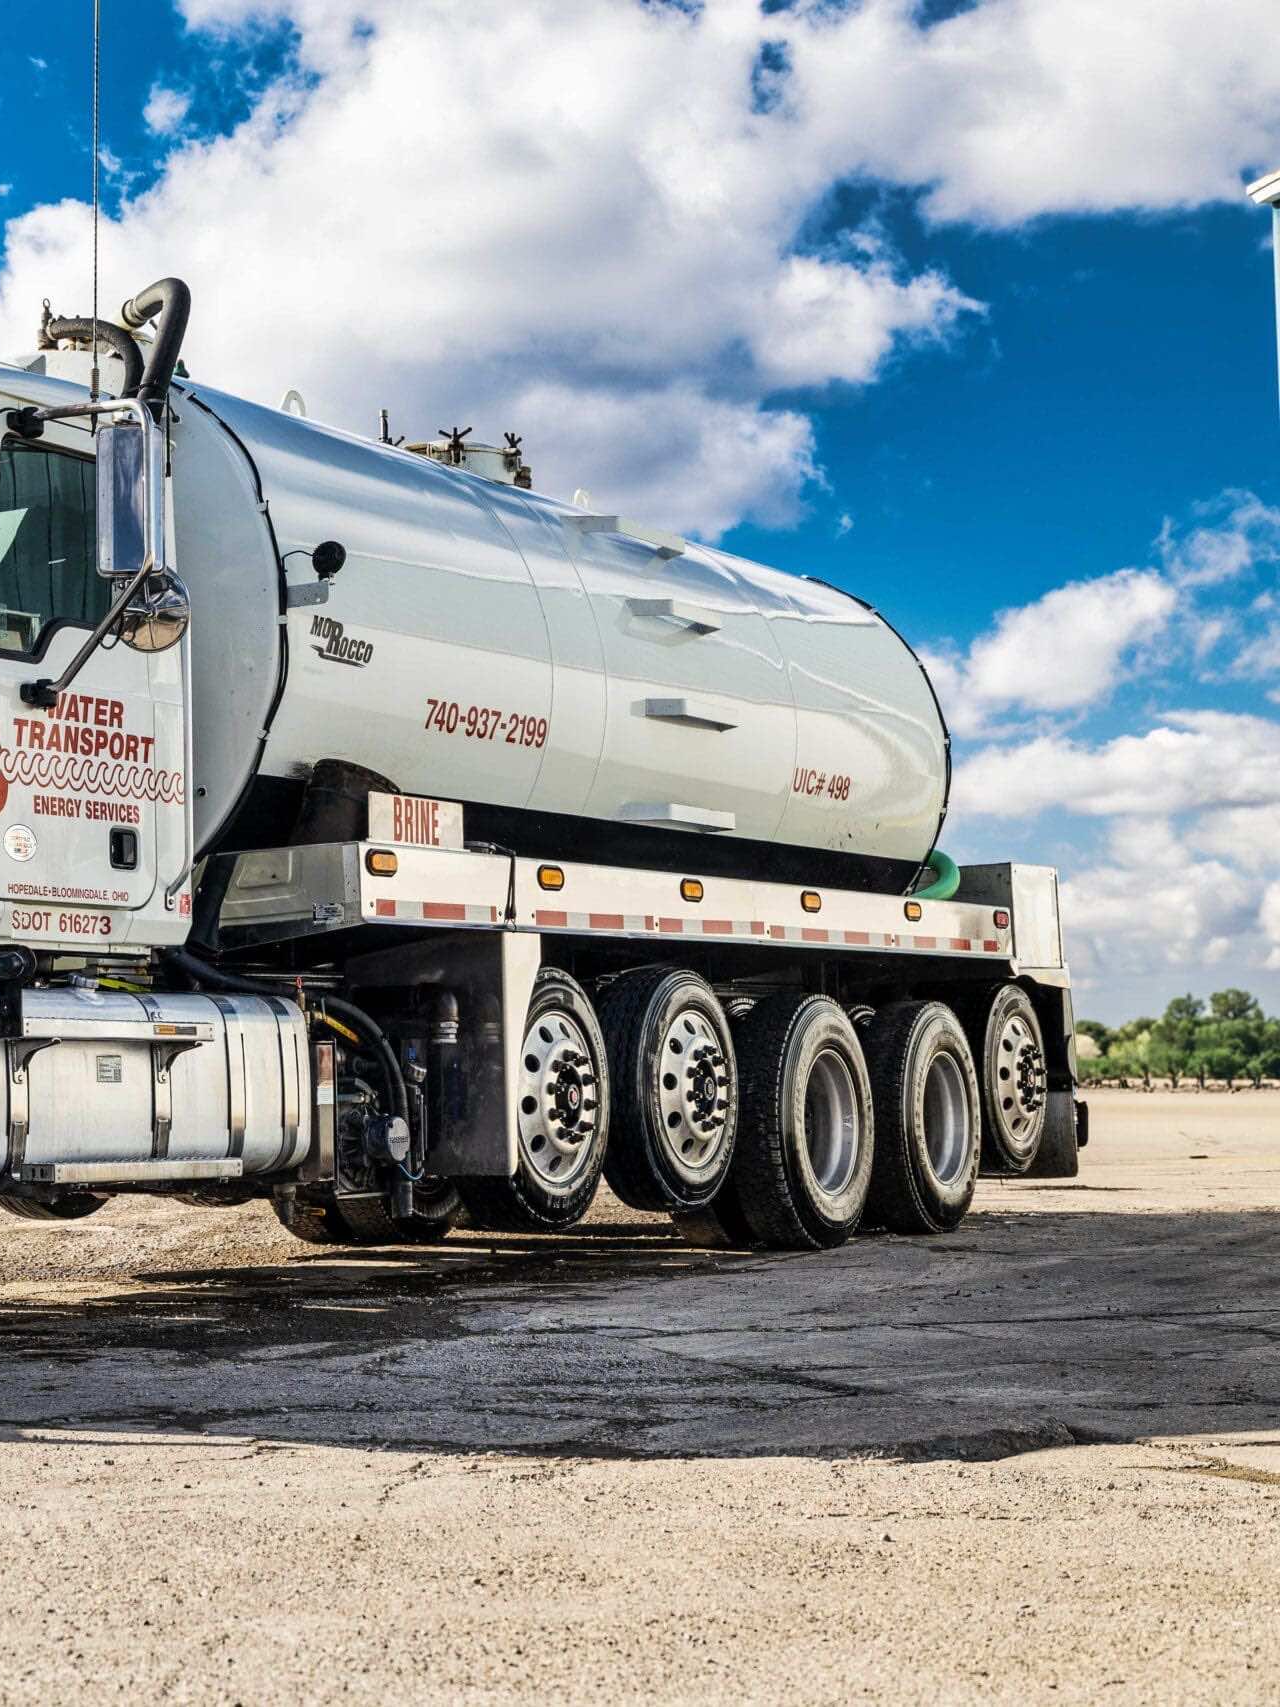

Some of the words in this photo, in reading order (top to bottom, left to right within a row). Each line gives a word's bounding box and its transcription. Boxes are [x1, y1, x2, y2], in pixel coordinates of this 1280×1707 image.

[425, 699, 547, 748] 740-937-2199
[13, 718, 155, 763] TRANSPORT
[793, 767, 825, 796] UIC#
[828, 775, 850, 800] 498
[34, 795, 82, 818] ENERGY
[85, 800, 139, 824] SERVICES
[394, 796, 439, 845] BRINE
[112, 891, 129, 902] OHIO
[12, 909, 52, 931] SDOT
[59, 913, 112, 935] 616273
